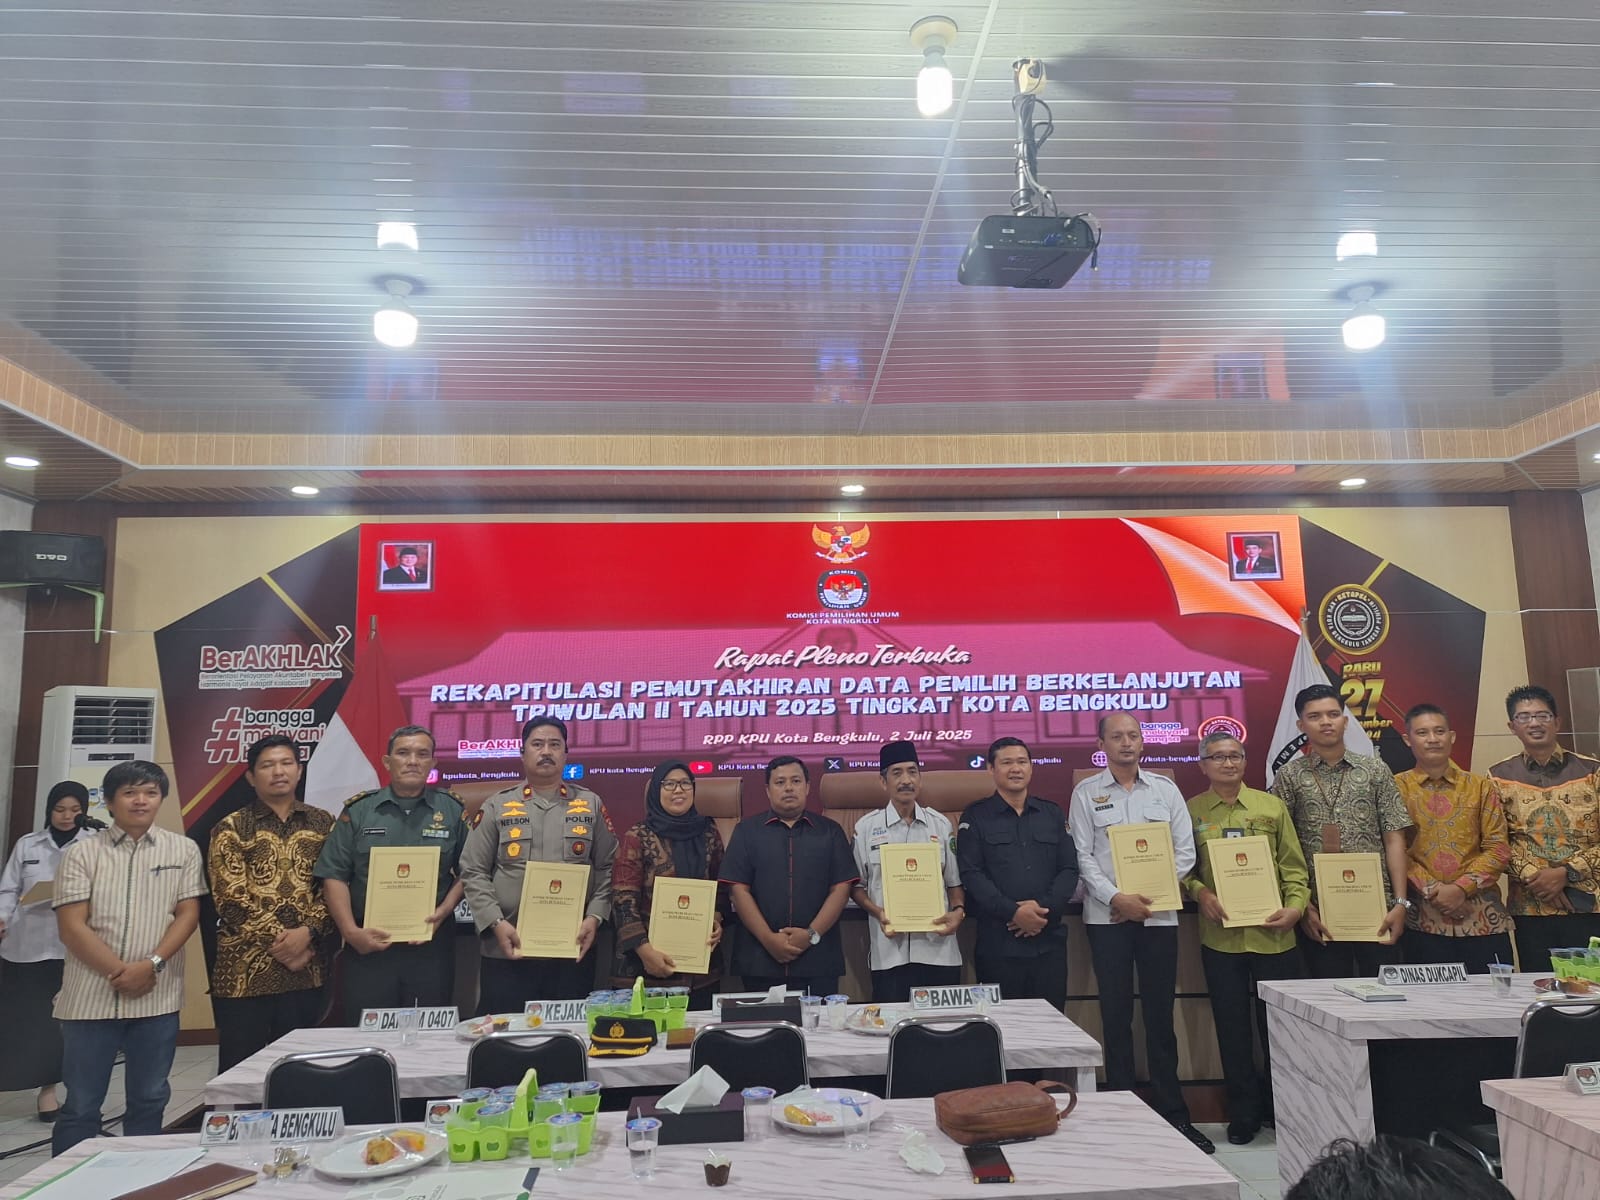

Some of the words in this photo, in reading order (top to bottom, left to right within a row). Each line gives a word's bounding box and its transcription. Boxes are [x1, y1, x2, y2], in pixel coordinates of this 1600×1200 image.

[200, 644, 343, 670] BerAKHLAK
[714, 646, 796, 672] Rapat
[794, 645, 869, 668] Pleno
[869, 644, 971, 667] Terbuka
[431, 681, 623, 702] REKAPITULASI
[630, 677, 831, 699] PEMUTAKHIRAN
[839, 676, 911, 695] DATA
[919, 674, 1017, 694] PEMILIH
[1026, 671, 1241, 691] BERKELANJUTAN
[512, 702, 645, 722] TRIWULAN
[654, 701, 670, 719] II
[678, 699, 768, 719] TAHUN
[775, 697, 836, 716] 2025
[846, 695, 953, 715] TINGKAT
[962, 695, 1031, 713] KOTA
[1039, 692, 1169, 712] BENGKULU
[1340, 679, 1385, 717] 27
[244, 709, 315, 727] bangga
[1141, 723, 1181, 732] bangga
[703, 735, 734, 745] RPP
[738, 733, 771, 744] KPU
[774, 733, 809, 744] Kota
[813, 731, 885, 745] Bengkulu,
[889, 731, 900, 742] 2
[902, 730, 932, 742] Juli
[935, 729, 973, 741] 2025
[500, 817, 530, 826] NELSON
[565, 816, 593, 824] POLRI
[1400, 967, 1426, 983] DINAS
[1425, 966, 1467, 983] DUKCAPIL
[930, 987, 1000, 1007] BAWAU
[427, 1010, 455, 1028] 0407
[280, 1111, 337, 1138] BENGKULU
